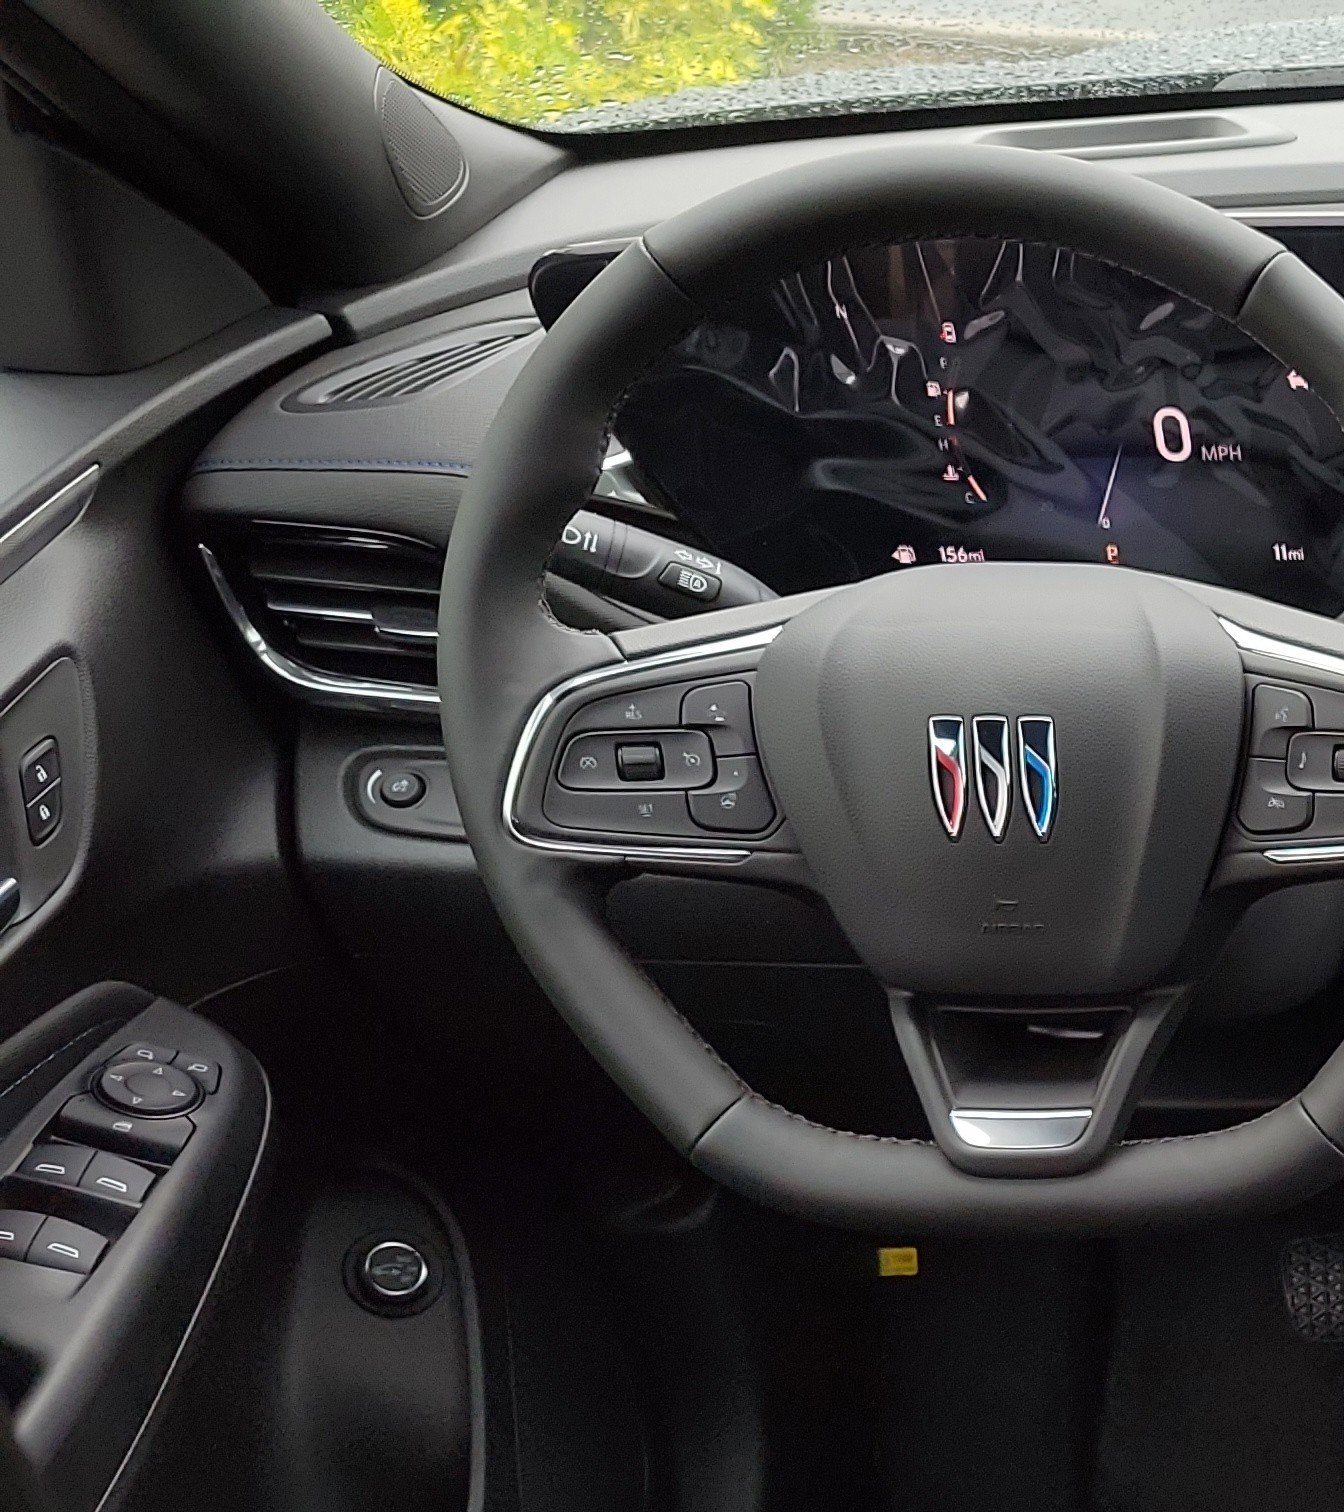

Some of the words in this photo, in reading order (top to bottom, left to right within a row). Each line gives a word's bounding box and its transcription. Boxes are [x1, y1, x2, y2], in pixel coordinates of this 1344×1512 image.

[933, 414, 943, 427] E
[1153, 406, 1192, 463] 0
[1201, 444, 1242, 462] MPH
